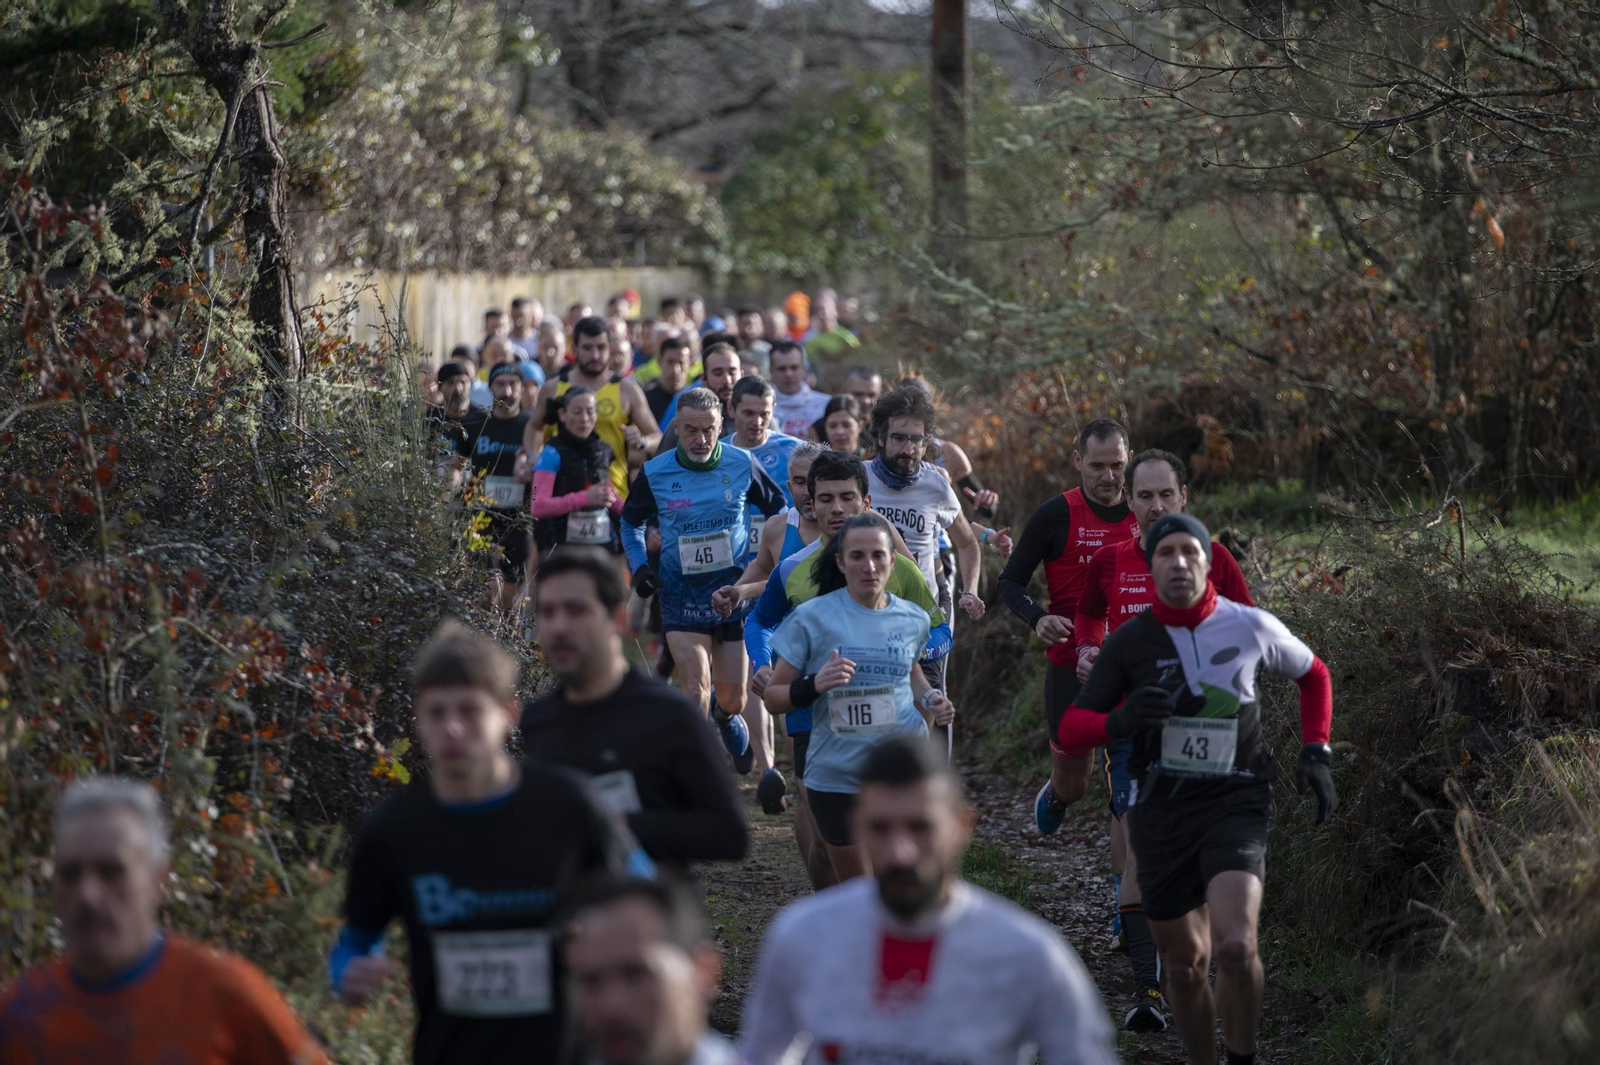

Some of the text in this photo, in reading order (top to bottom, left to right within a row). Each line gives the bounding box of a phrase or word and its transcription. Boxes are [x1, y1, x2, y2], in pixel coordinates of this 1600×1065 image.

[683, 519, 722, 532] ATLETISMO
[875, 506, 925, 533] PRENDO
[580, 523, 596, 536] 44
[750, 528, 759, 544] 3
[695, 546, 713, 564] 46
[1079, 555, 1085, 563] A
[1120, 603, 1153, 614] A BOUT
[874, 666, 887, 675] DE
[845, 689, 862, 697] CROSS
[848, 703, 872, 725] 116
[1181, 736, 1209, 760] 43
